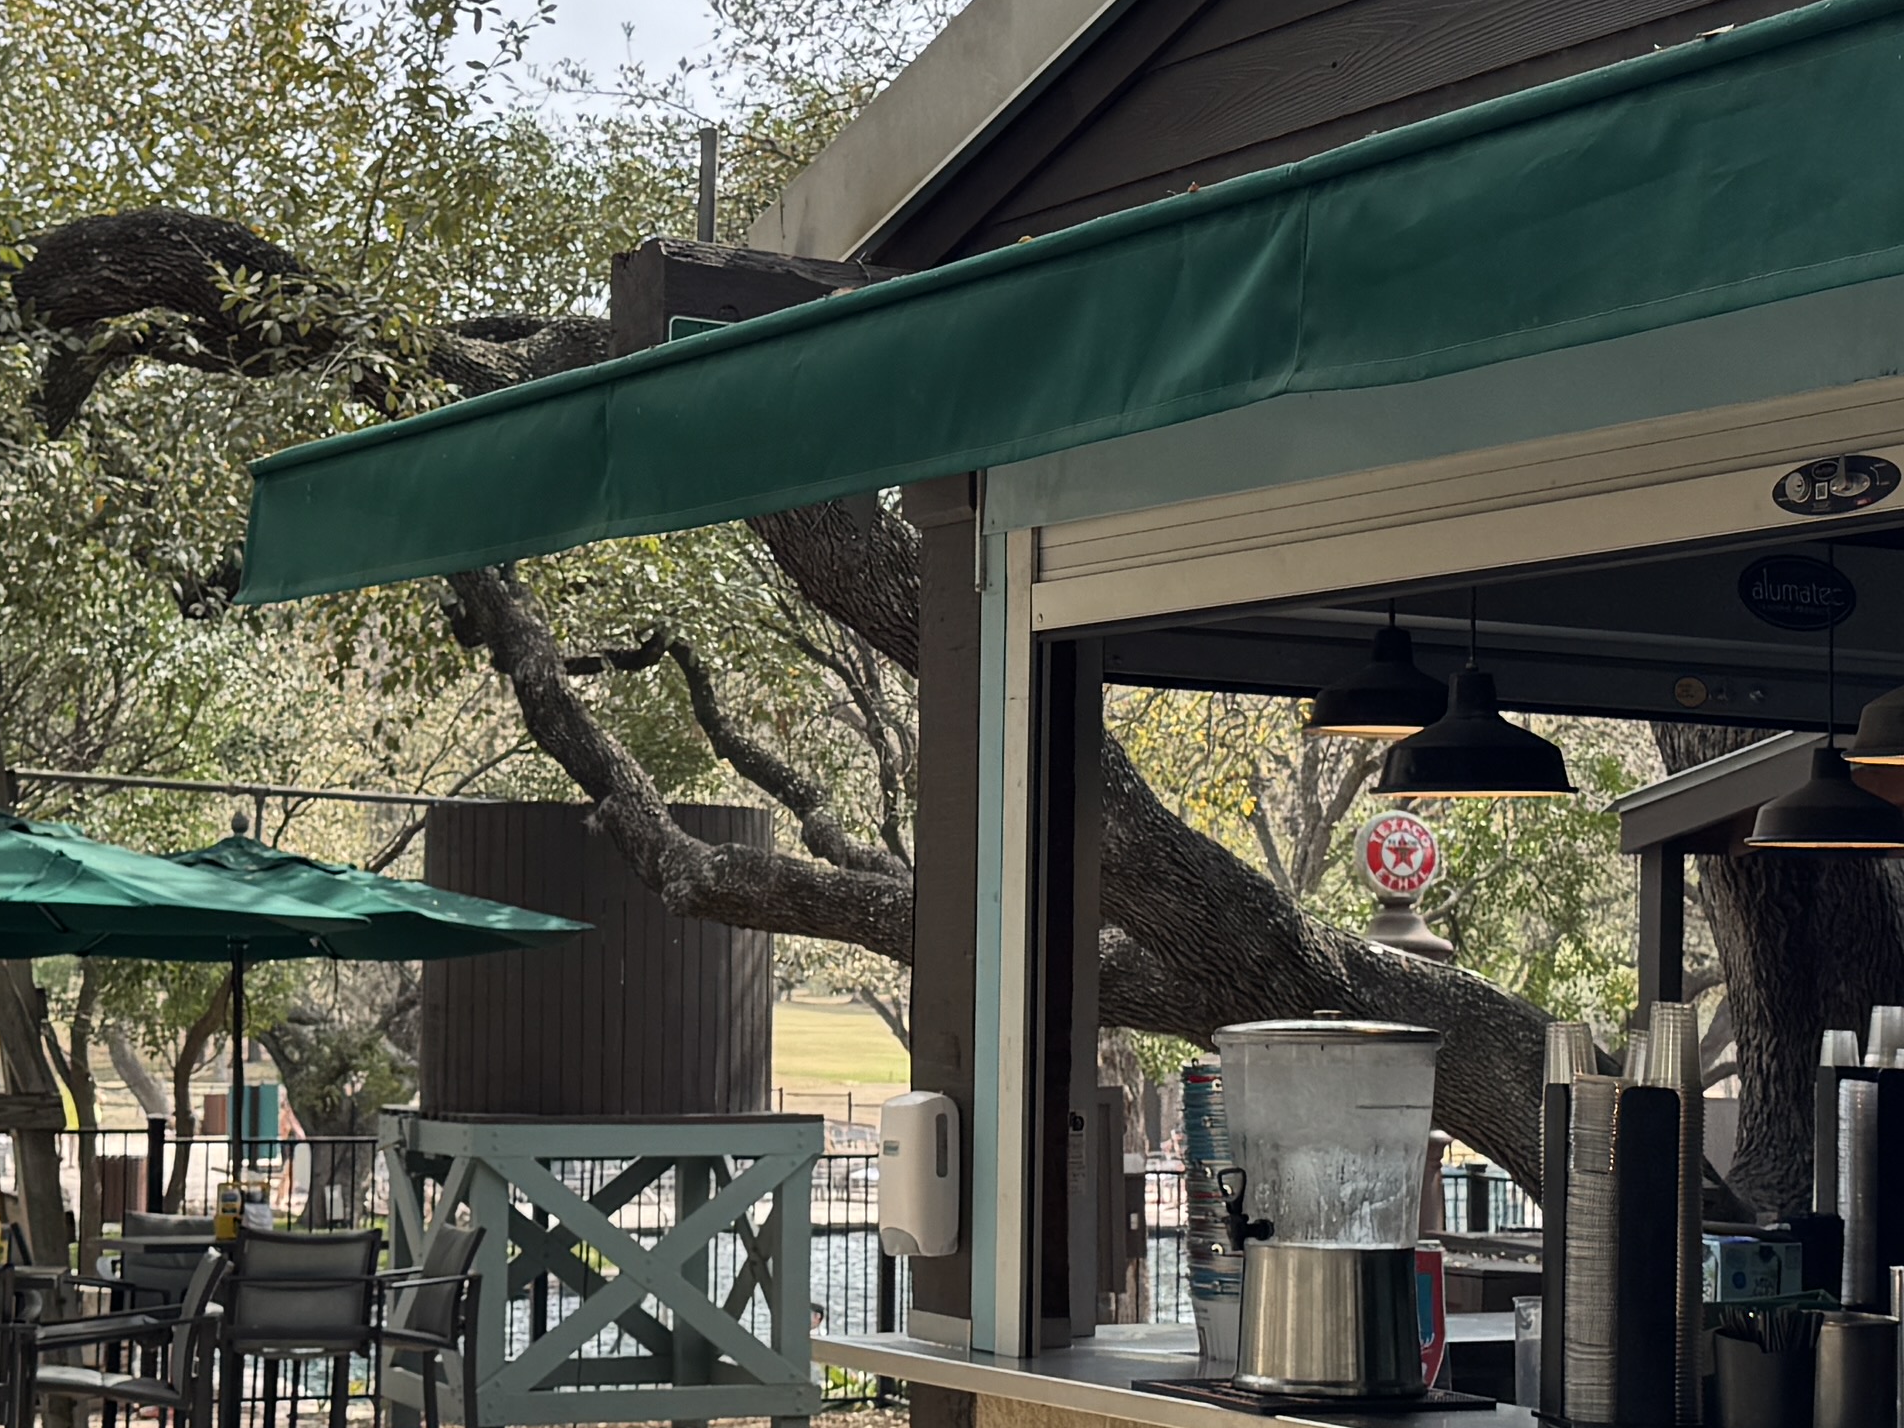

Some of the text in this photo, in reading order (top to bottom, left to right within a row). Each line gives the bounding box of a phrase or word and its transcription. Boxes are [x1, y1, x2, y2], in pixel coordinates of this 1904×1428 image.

[1751, 566, 1846, 607] alumatec
[1369, 818, 1431, 848] TEXACO
[1376, 868, 1429, 891] ETHYL
